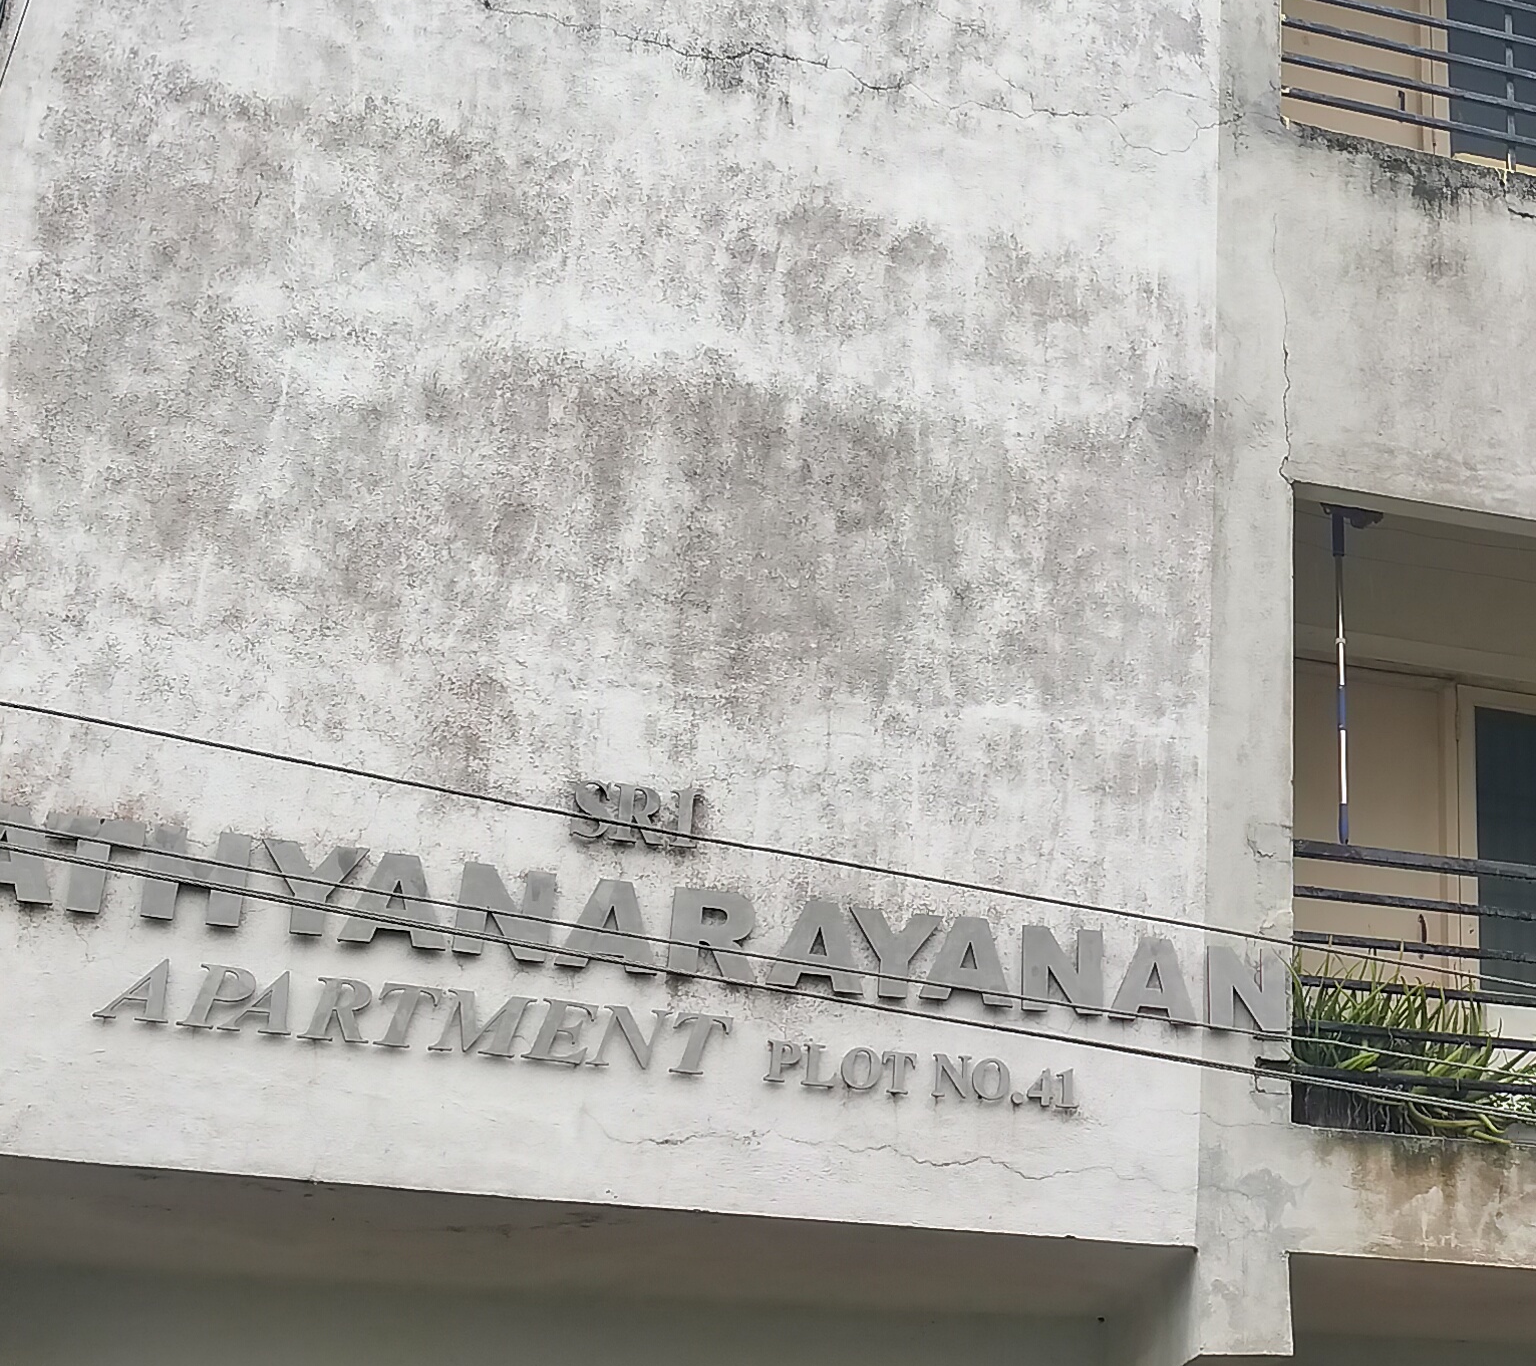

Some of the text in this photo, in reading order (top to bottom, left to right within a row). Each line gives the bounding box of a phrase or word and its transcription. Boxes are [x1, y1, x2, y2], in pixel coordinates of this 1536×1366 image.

[570, 781, 703, 848] SRI
[92, 958, 1080, 1112] APARTMENT PLOT NO.41
